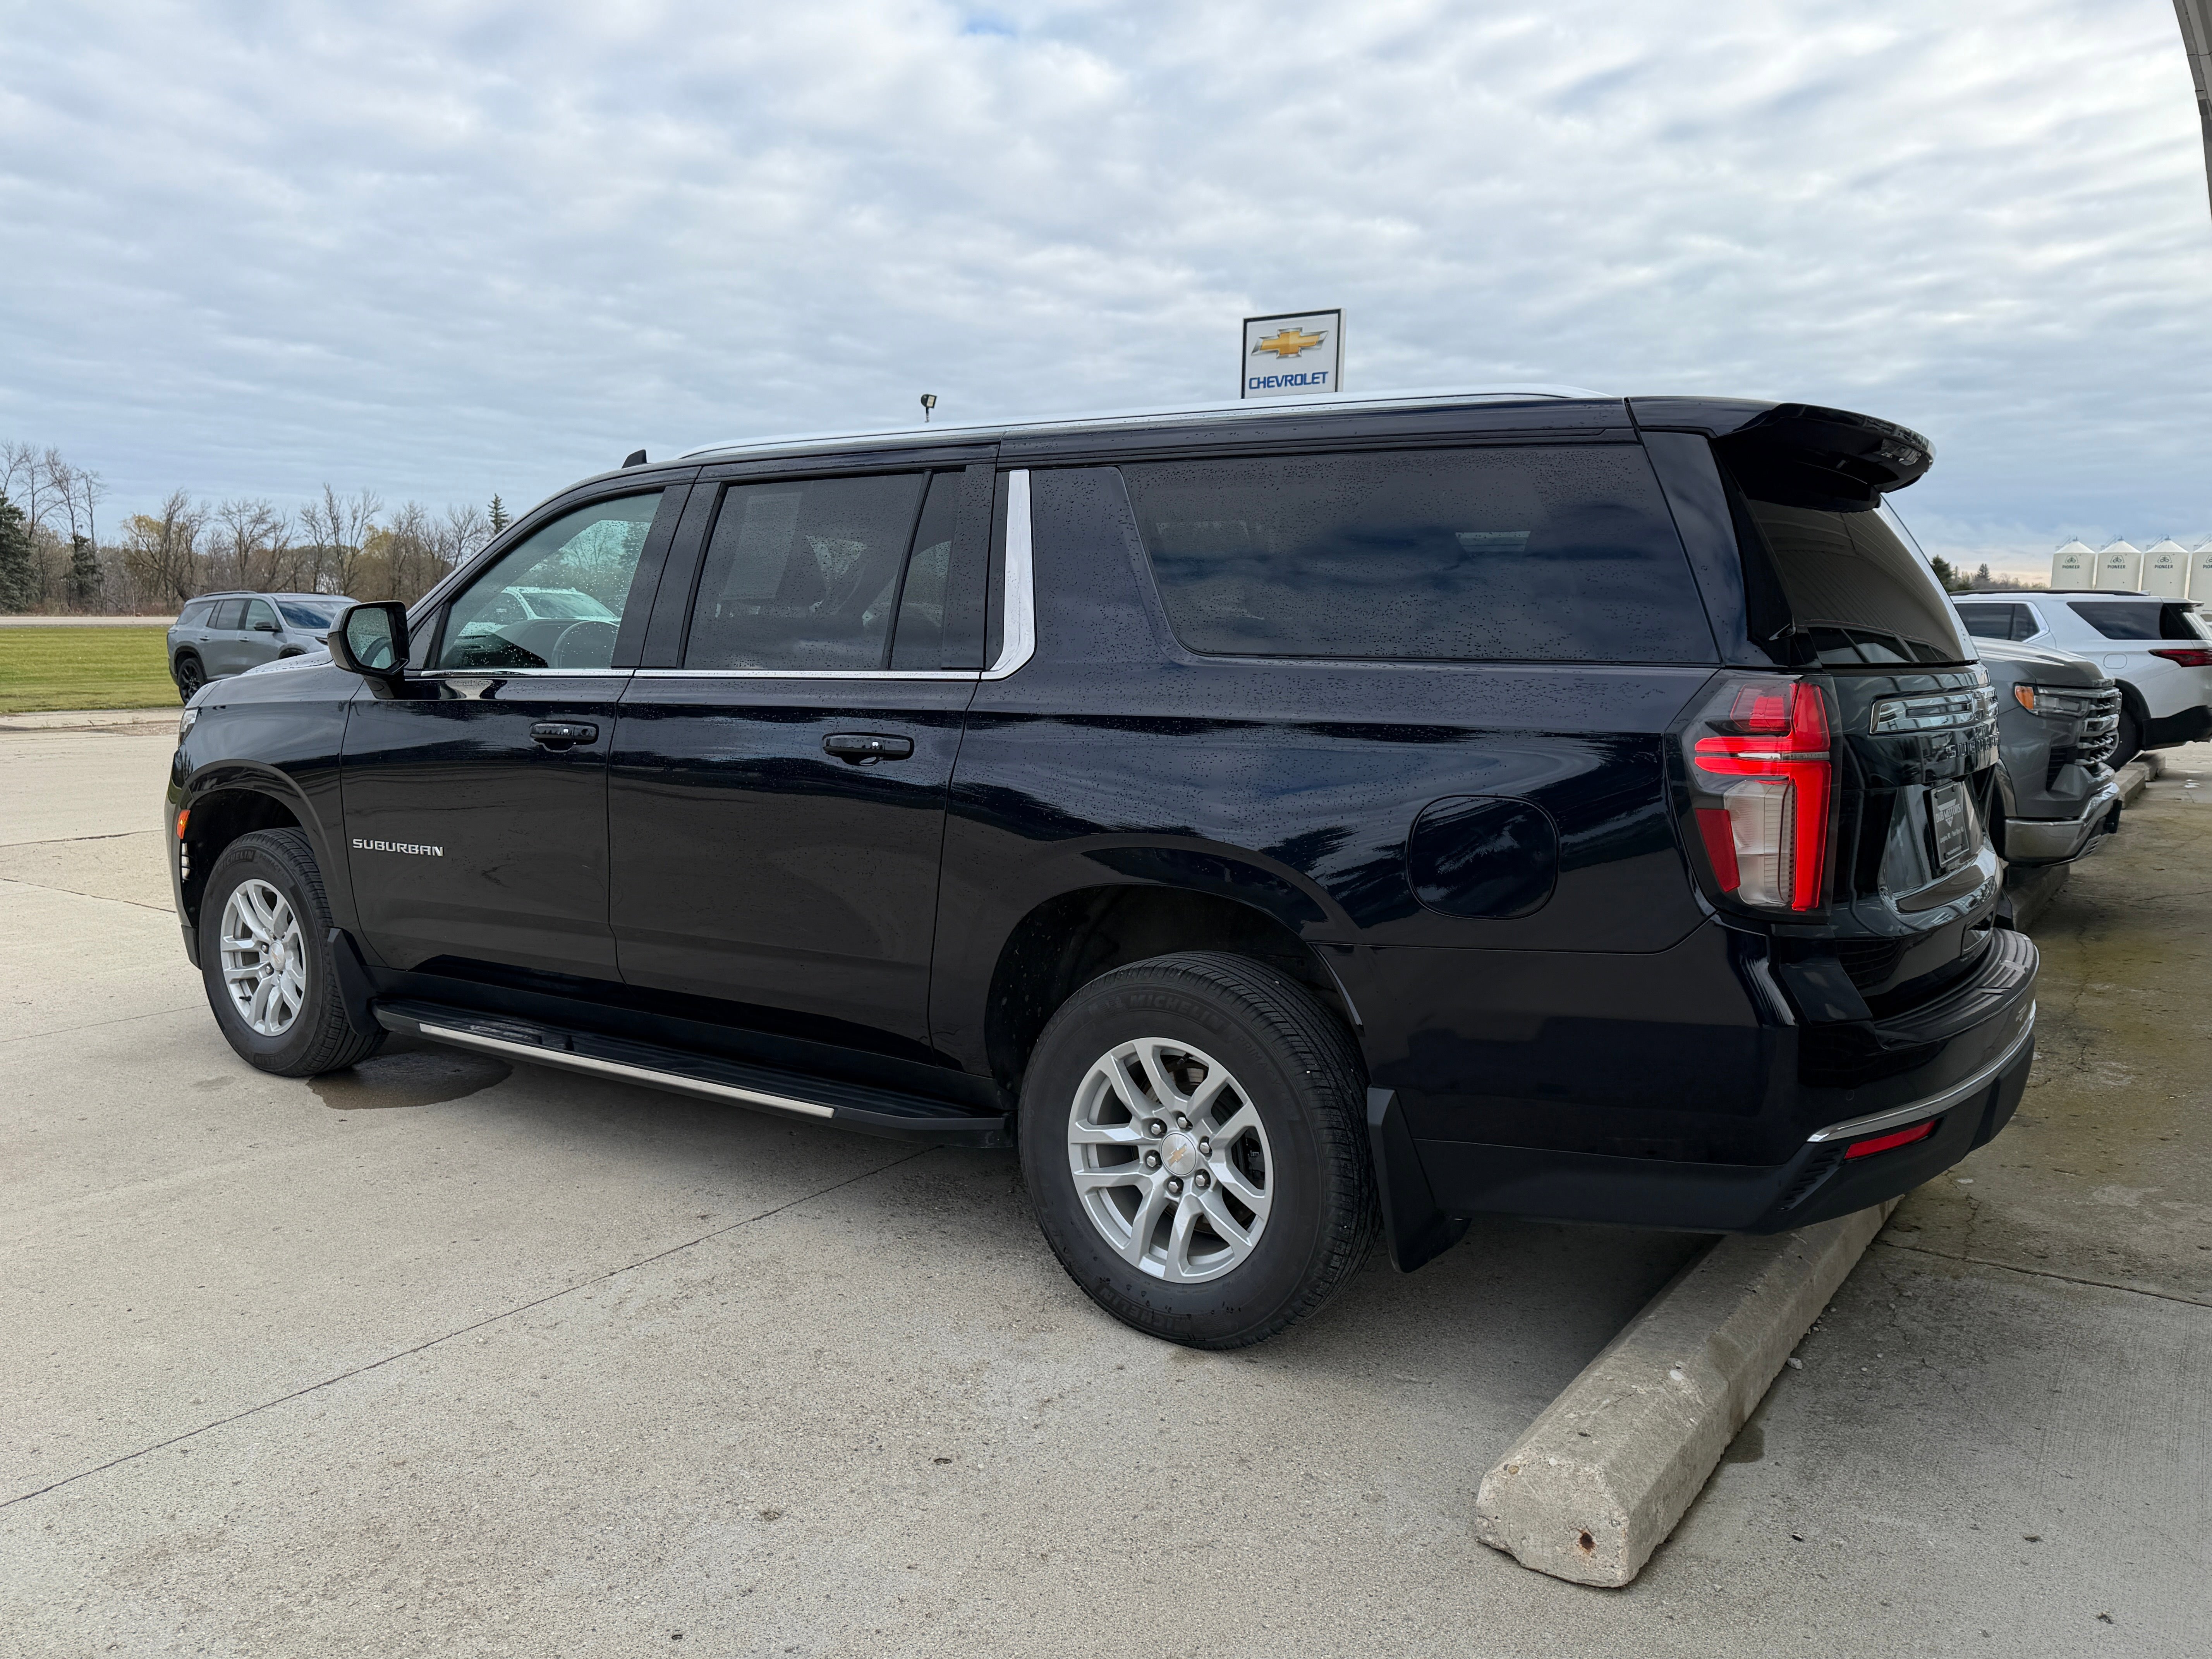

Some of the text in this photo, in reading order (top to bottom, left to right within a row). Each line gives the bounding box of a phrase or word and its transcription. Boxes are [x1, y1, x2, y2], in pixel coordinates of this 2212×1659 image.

[1249, 371, 1329, 390] CHEVROLET
[1944, 804, 1961, 819] MOTORS
[353, 838, 444, 857] SUBURBAN
[1130, 994, 1224, 1030] MICHELIN
